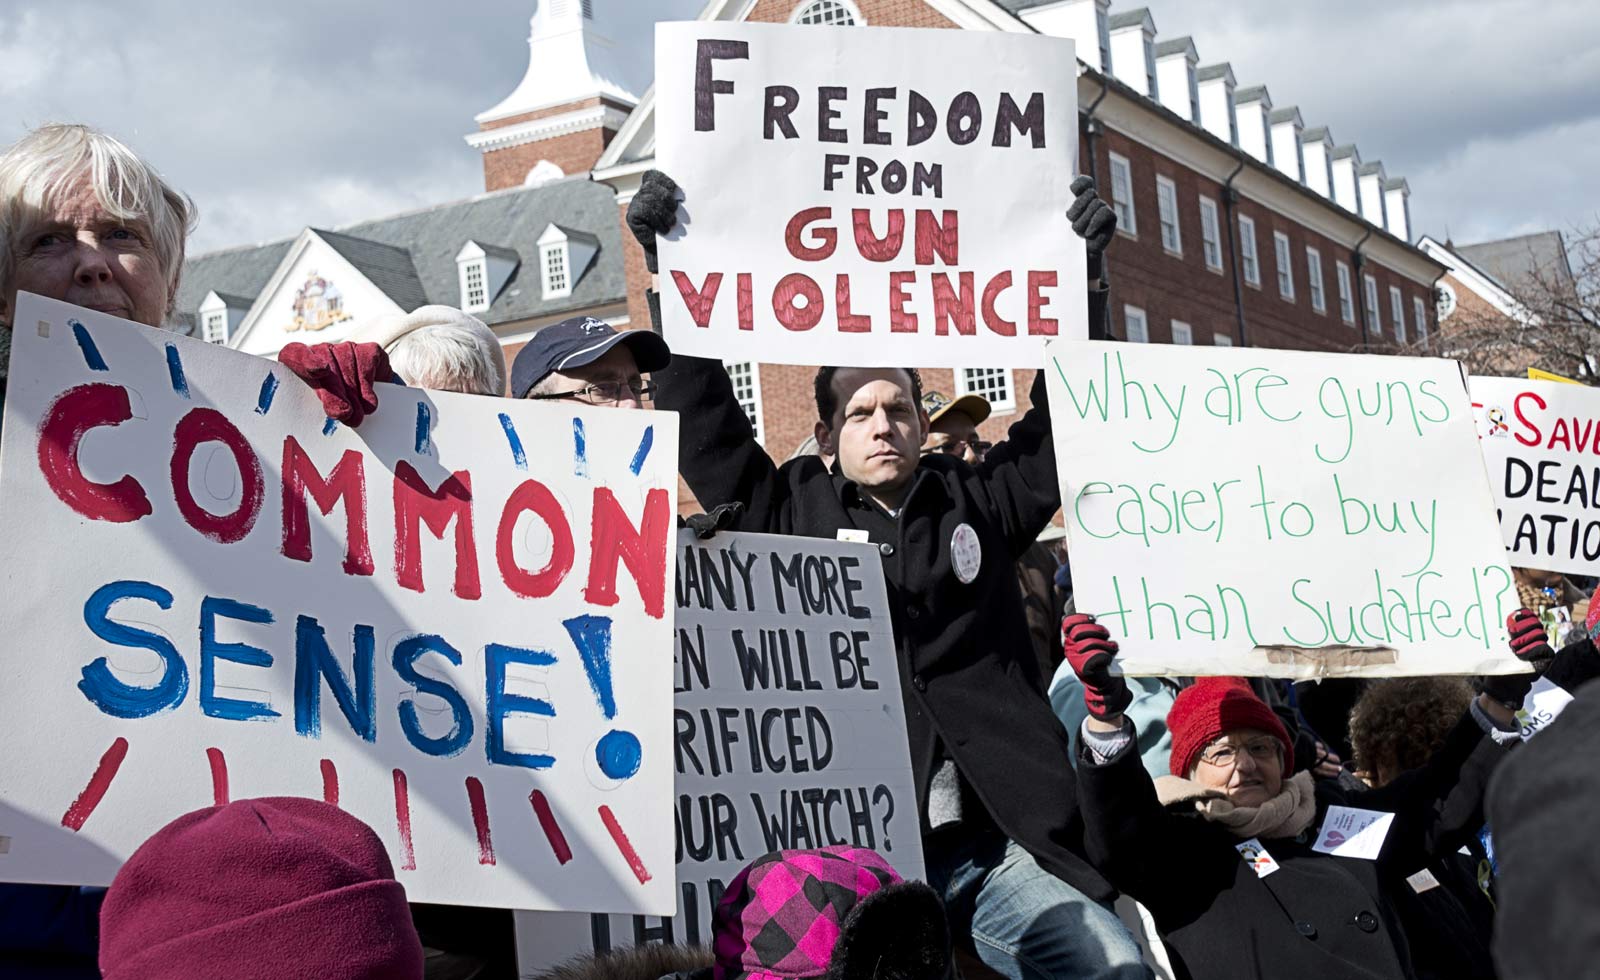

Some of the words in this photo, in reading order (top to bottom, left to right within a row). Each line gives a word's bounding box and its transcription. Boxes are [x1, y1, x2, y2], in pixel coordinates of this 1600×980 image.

[694, 39, 1046, 149] FREEDOM
[823, 153, 943, 198] FROM
[785, 207, 959, 266] GUN
[670, 270, 1059, 337] VIOLENCE
[1053, 351, 1186, 454] Why
[1203, 367, 1302, 426] are
[1315, 376, 1450, 464] guns
[38, 382, 671, 619] COMMON
[1075, 479, 1241, 548] easier
[1252, 464, 1315, 540] to
[1333, 473, 1438, 577] buy
[1496, 508, 1600, 562] ATIO
[676, 545, 757, 612] ANY
[769, 551, 872, 619] MORE
[1096, 575, 1259, 647] than
[1282, 560, 1512, 651] Sudafed?
[77, 580, 643, 780] SENSE!
[731, 628, 823, 692] WILL
[829, 630, 879, 691] BE
[749, 783, 895, 852] WATCH?
